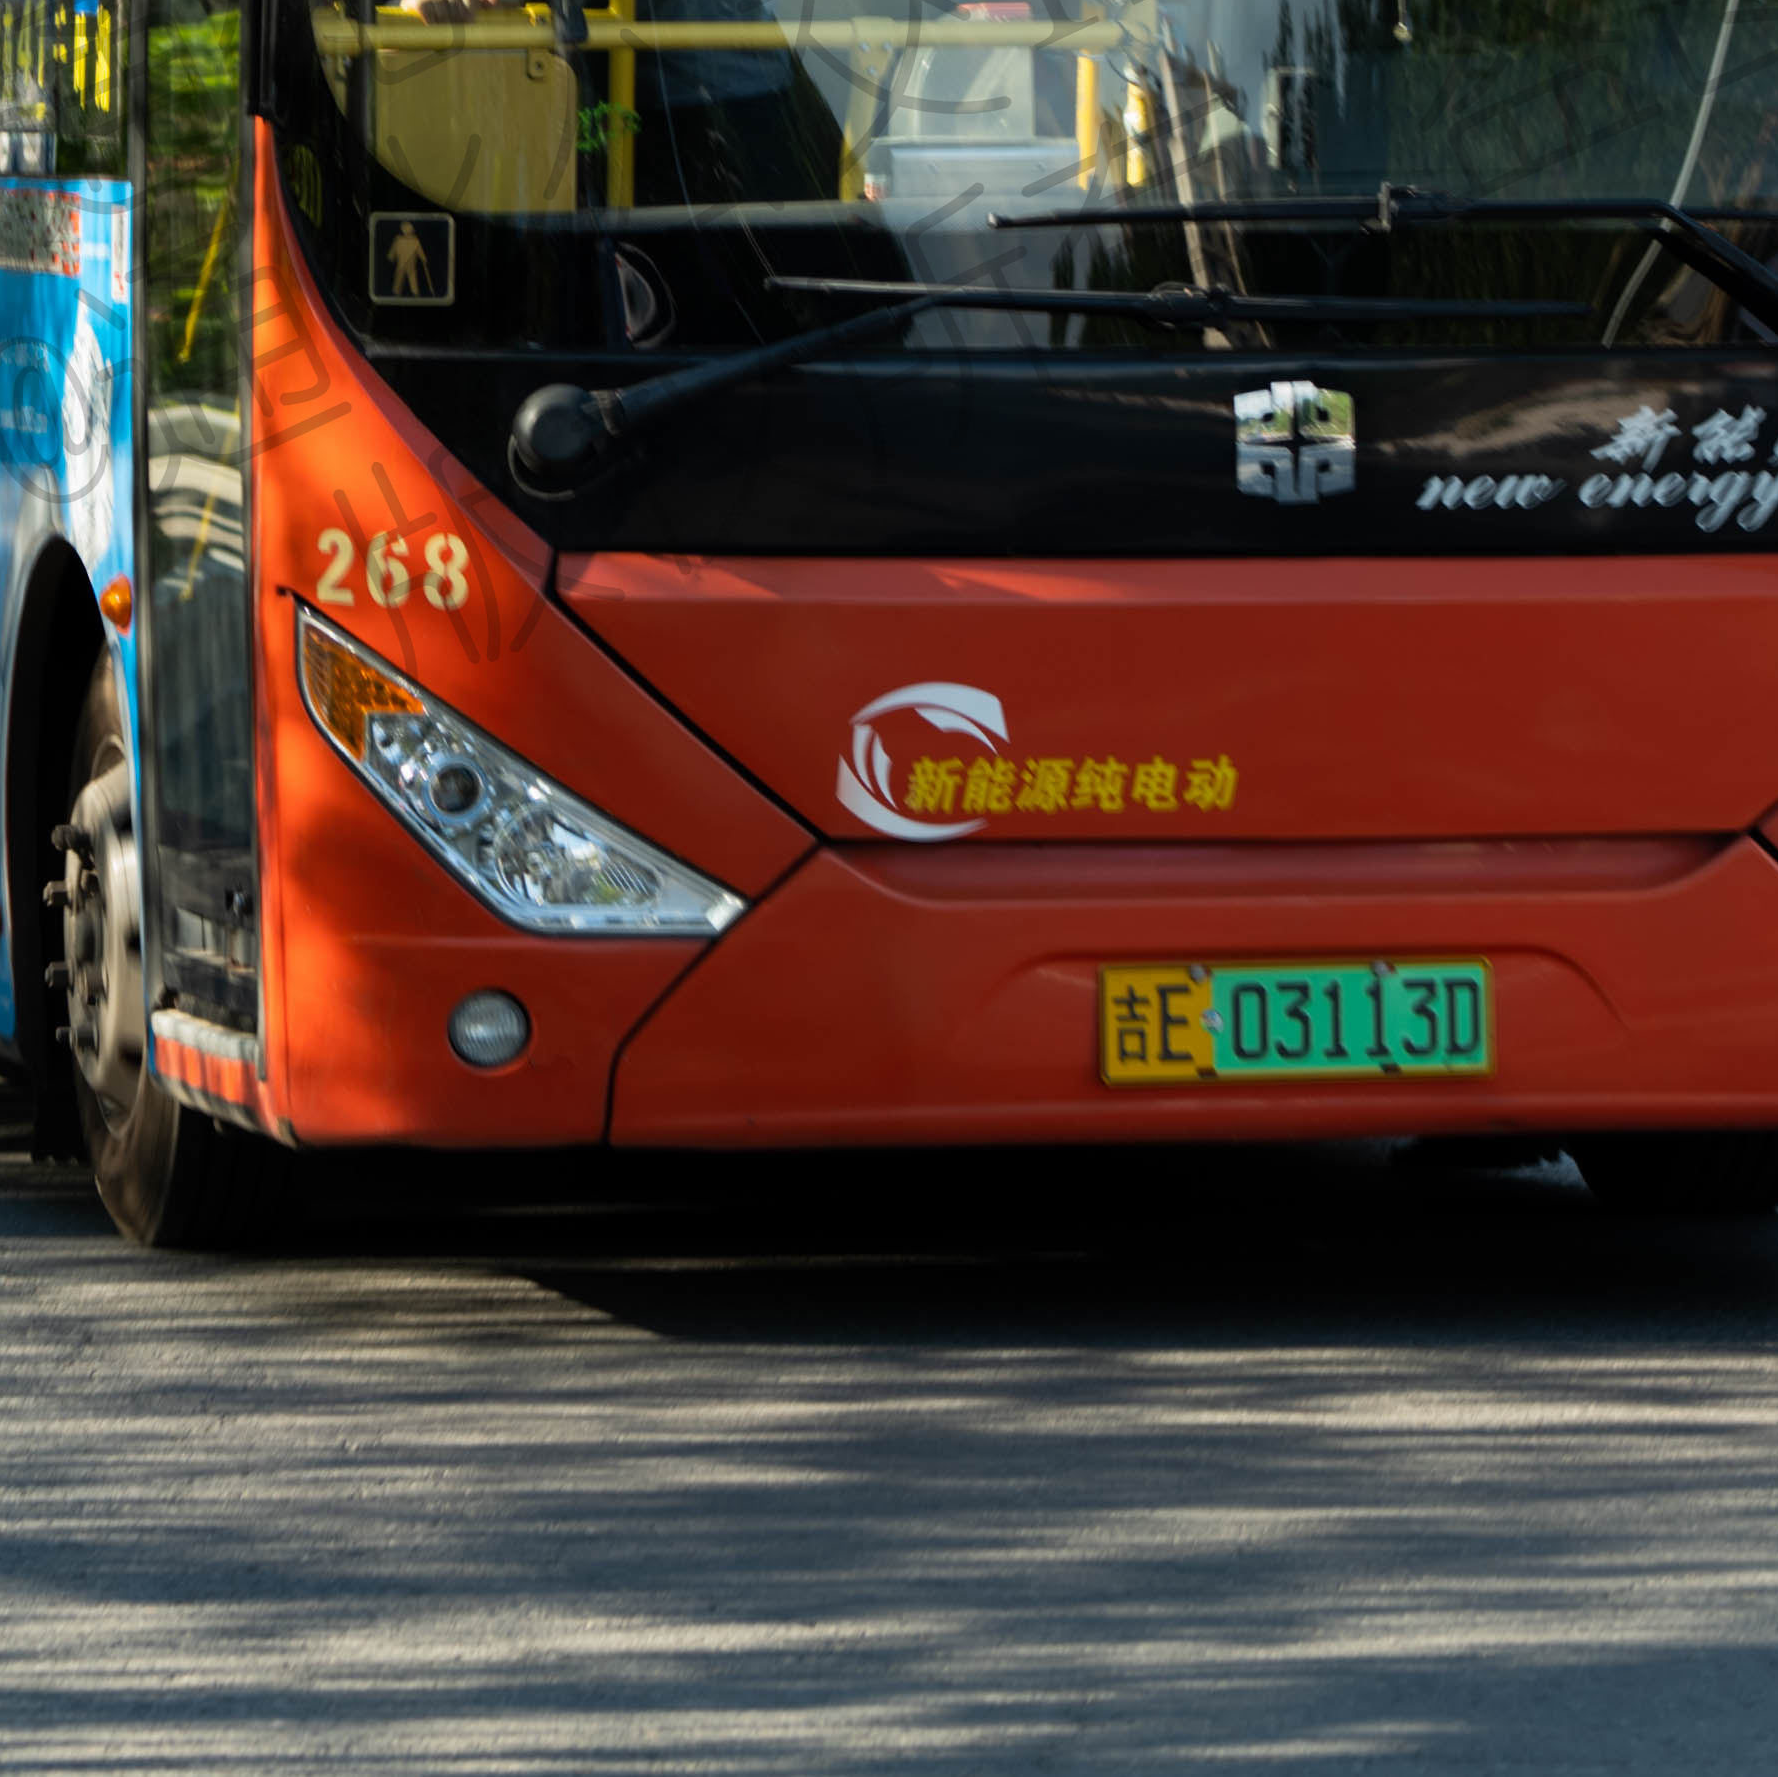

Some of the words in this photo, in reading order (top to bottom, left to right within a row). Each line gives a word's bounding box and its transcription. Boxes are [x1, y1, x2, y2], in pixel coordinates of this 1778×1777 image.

[1415, 473, 1567, 511] new
[316, 527, 470, 611] 268
[903, 753, 1241, 815] 新能源纯电动
[1110, 983, 1195, 1066] 吉E
[1230, 976, 1481, 1064] 03113D
